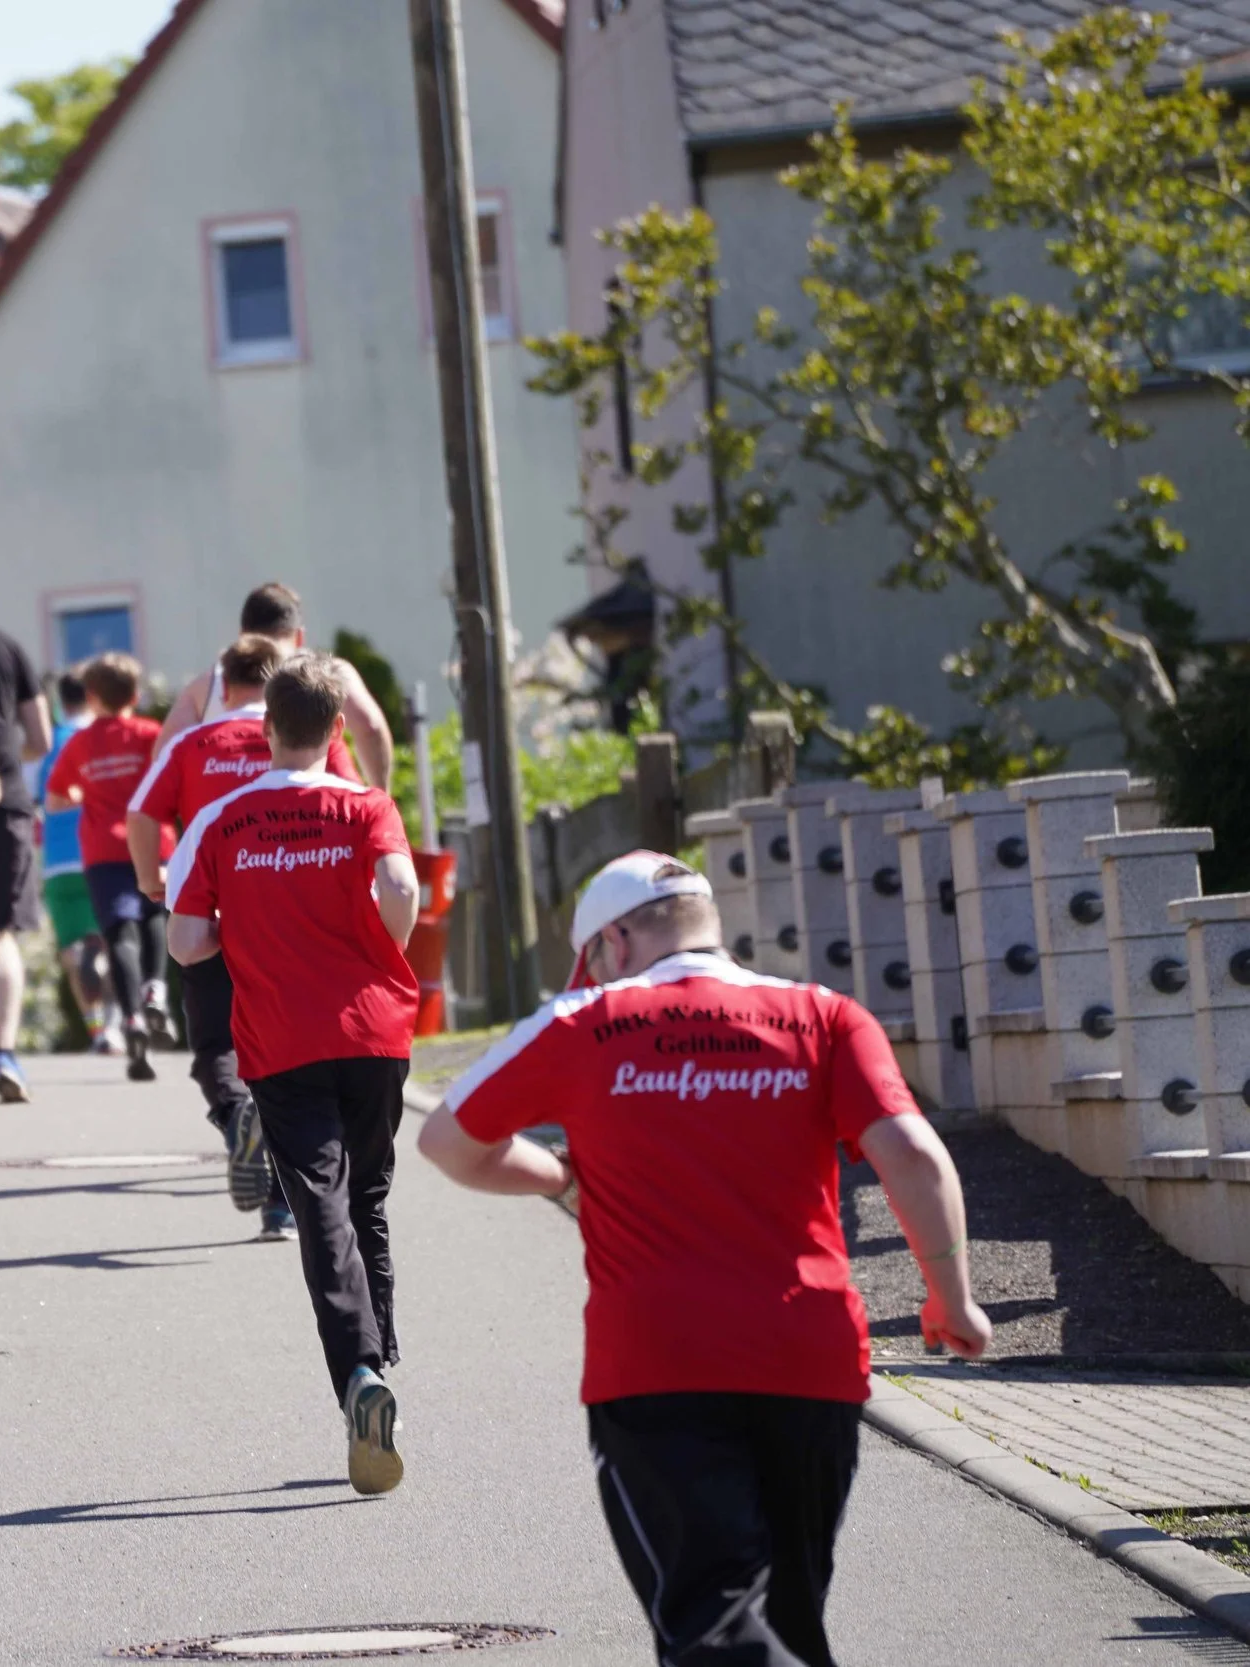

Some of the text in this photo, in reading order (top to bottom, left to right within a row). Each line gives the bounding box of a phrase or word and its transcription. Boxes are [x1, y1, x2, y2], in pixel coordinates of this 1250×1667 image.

[203, 754, 272, 777] Laufgru
[222, 812, 259, 838] DRK
[258, 827, 323, 842] Geithain
[234, 845, 354, 872] Laufgruppe
[593, 1008, 656, 1045] DRK
[654, 1033, 762, 1055] Geithain
[610, 1059, 810, 1101] Laufgruppe
